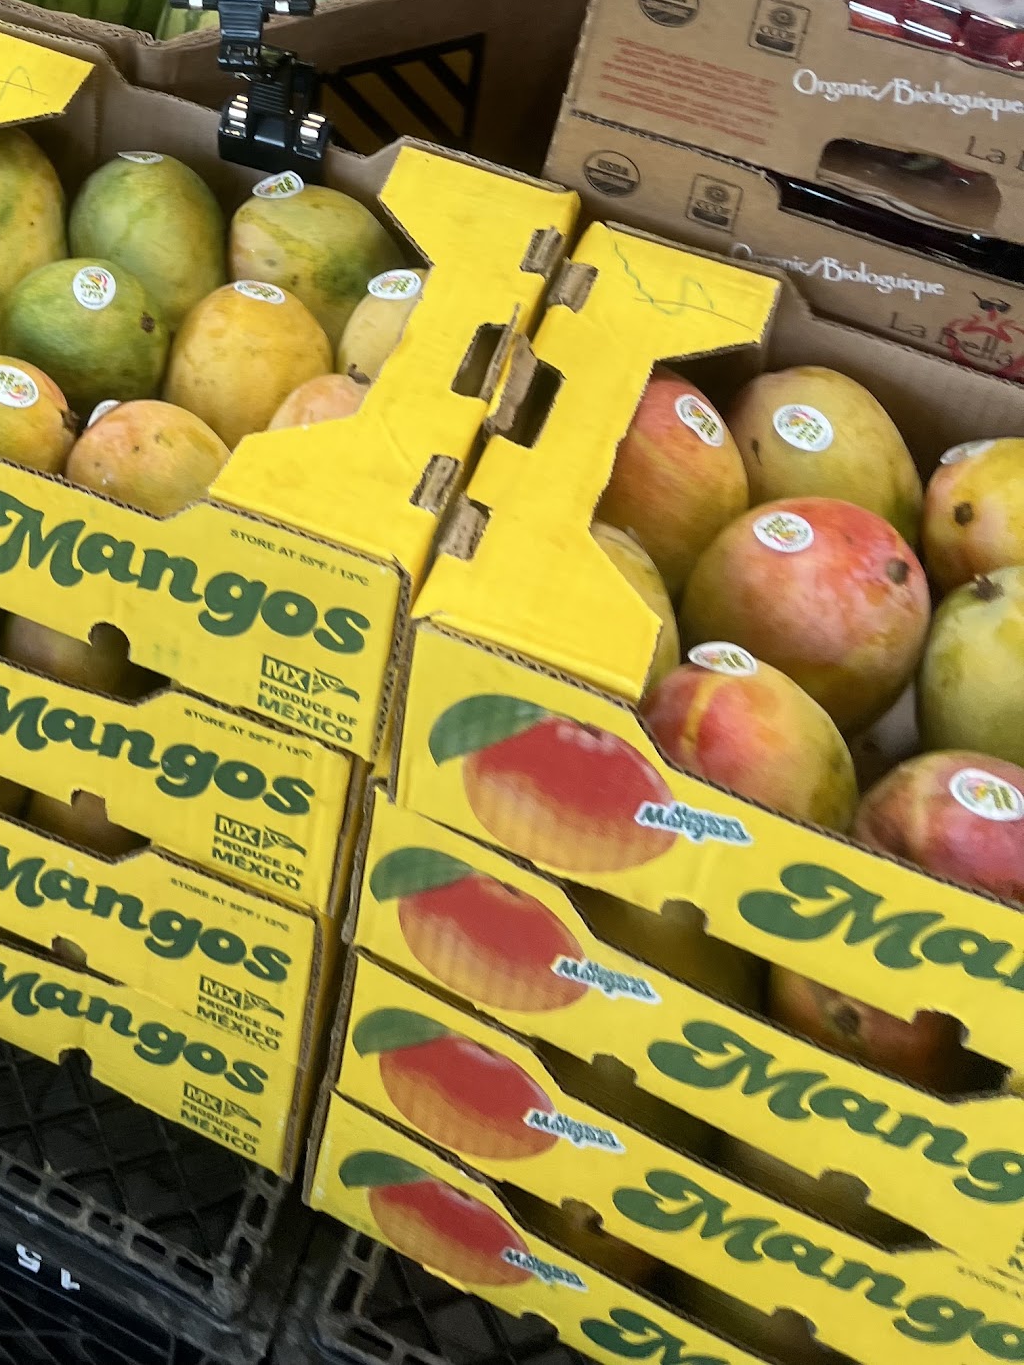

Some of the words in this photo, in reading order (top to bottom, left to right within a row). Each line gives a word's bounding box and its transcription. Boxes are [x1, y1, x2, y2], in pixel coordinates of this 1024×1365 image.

[966, 135, 1006, 165] La
[888, 312, 927, 339] La
[230, 529, 276, 552] STORE
[279, 545, 296, 559] AT
[264, 659, 309, 691] MX
[257, 693, 353, 744] MÉXICO
[259, 679, 332, 715] PRODUCE
[336, 712, 358, 727] OF
[184, 708, 226, 730] STORE
[229, 724, 245, 736] AT
[218, 818, 257, 845] MX
[212, 847, 301, 892] MÉXICO
[213, 835, 282, 868] PRODUCE
[285, 863, 304, 877] OF
[170, 877, 209, 900] STORE
[202, 977, 241, 1007] MX
[198, 994, 262, 1031] PRODUCE
[265, 1025, 283, 1039] OF
[181, 1100, 241, 1135] PRODUCE
[243, 1130, 260, 1144] OF
